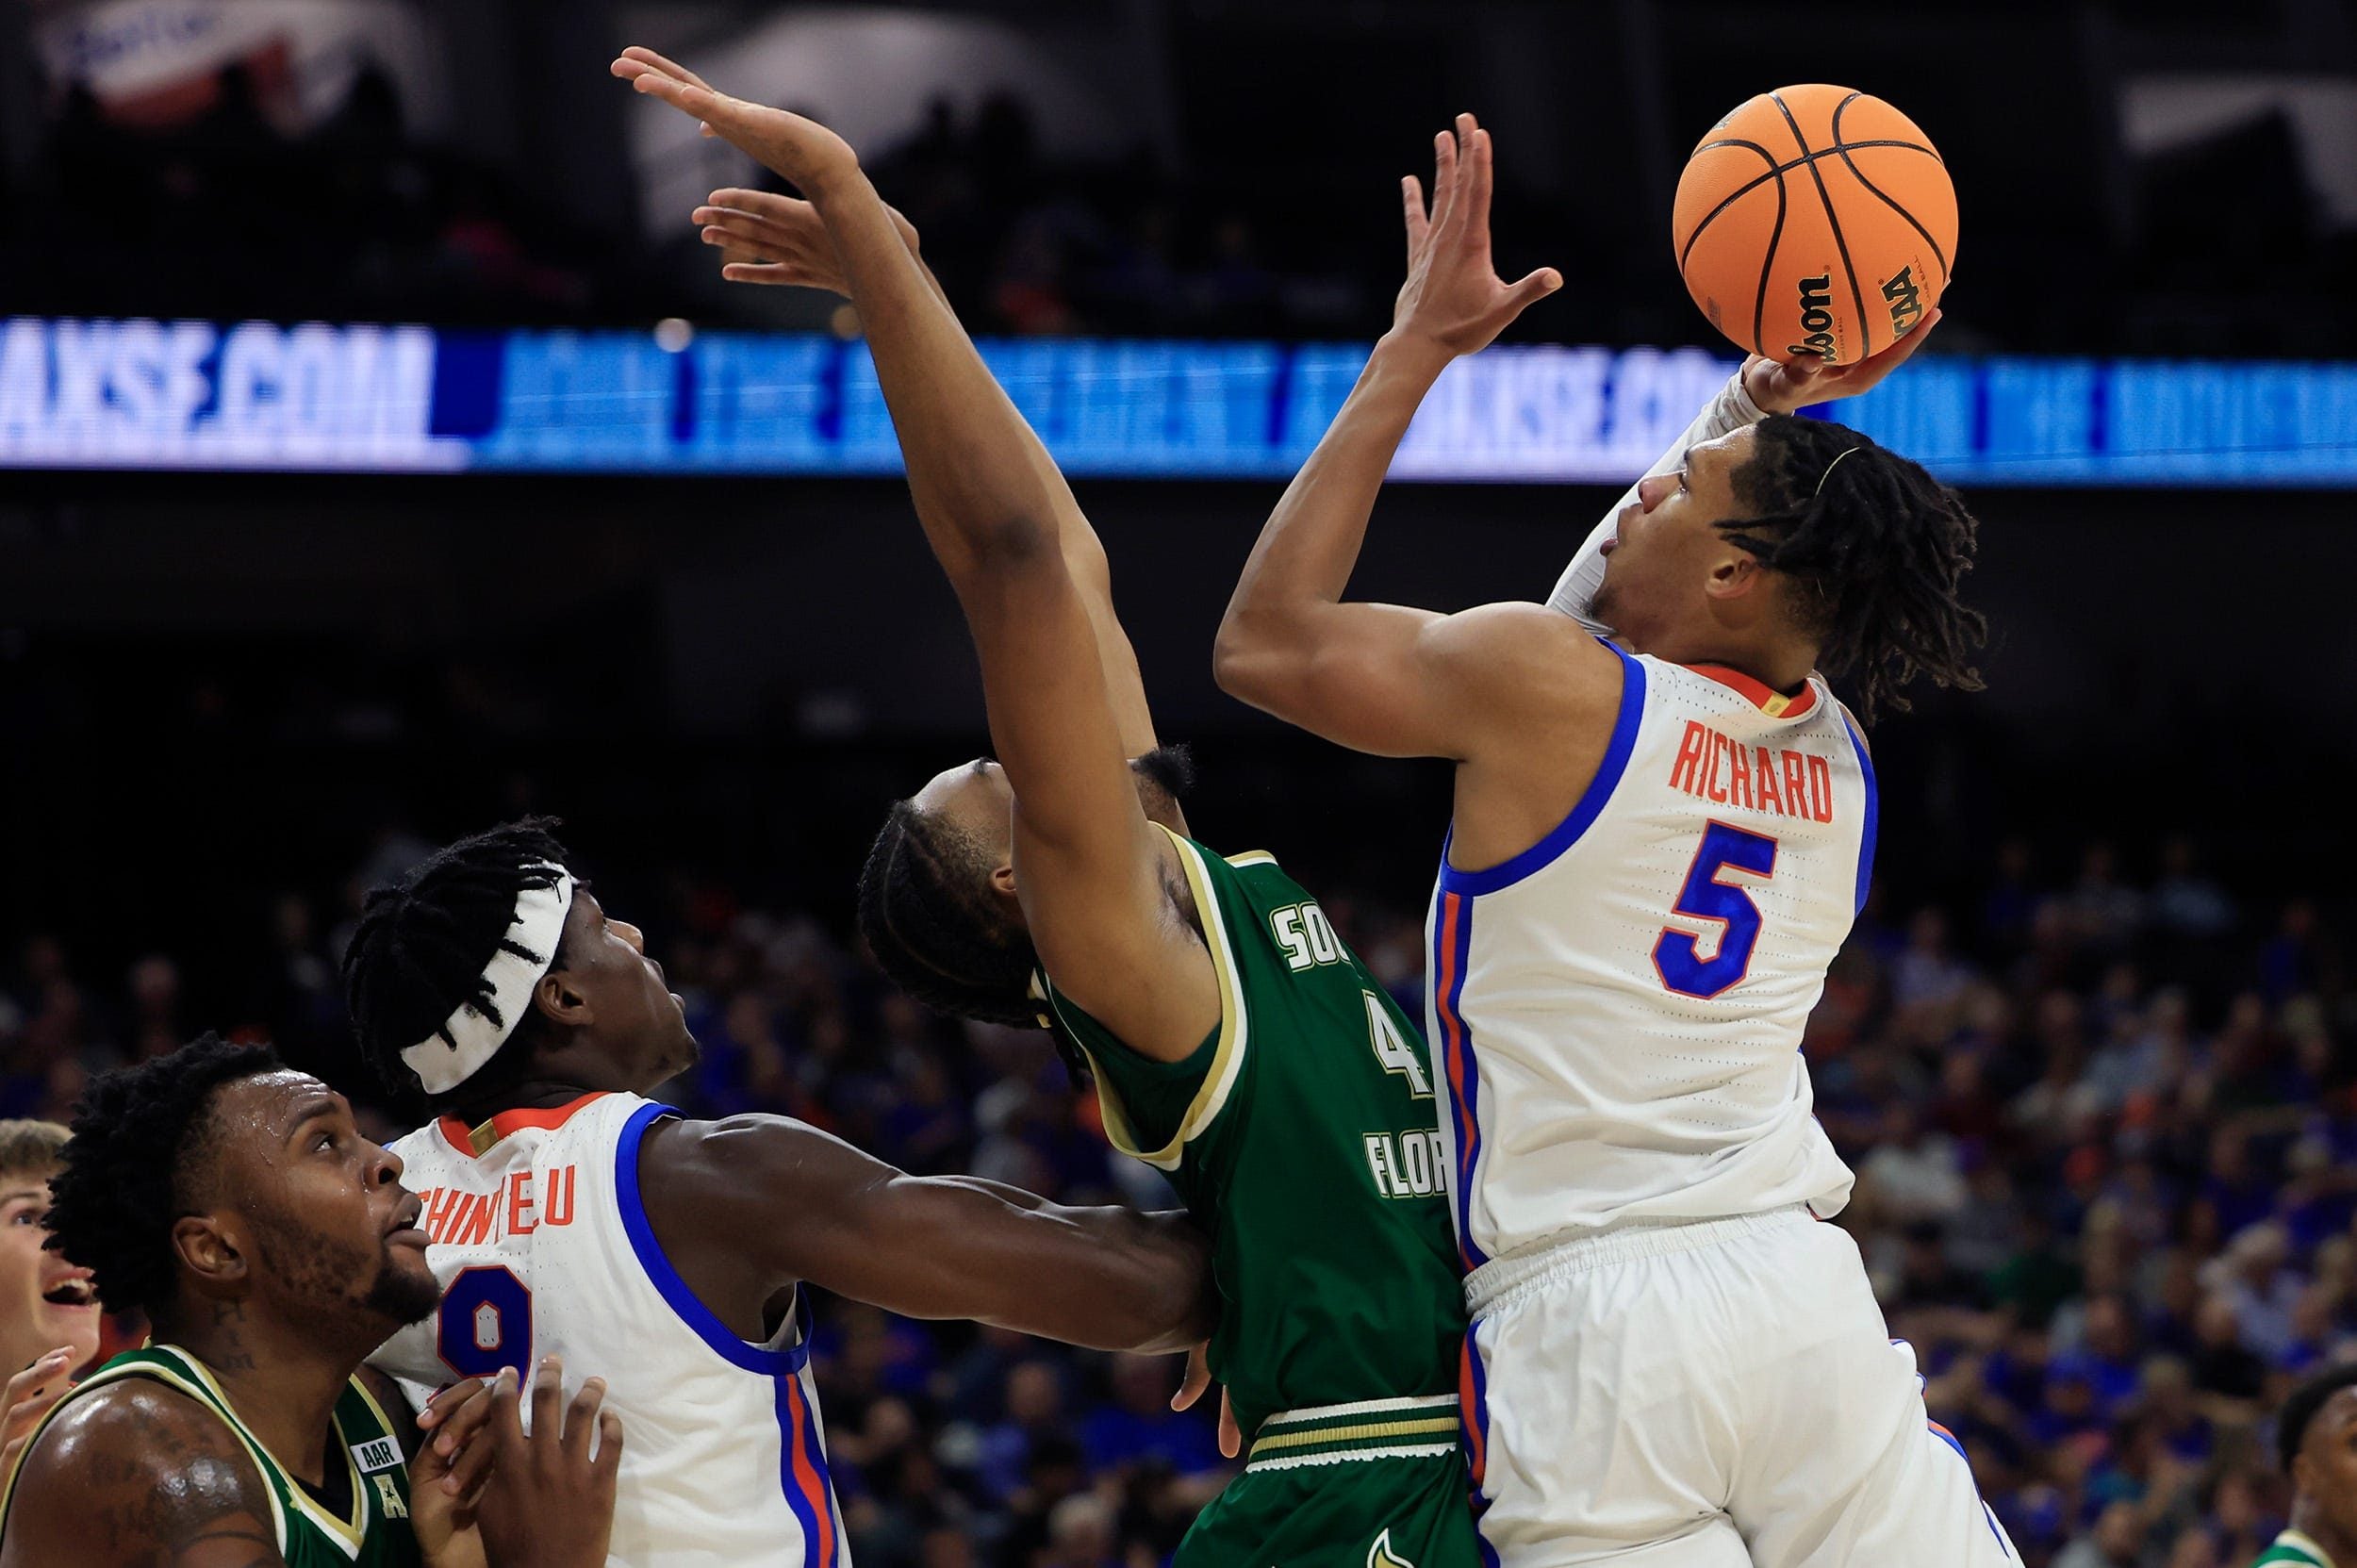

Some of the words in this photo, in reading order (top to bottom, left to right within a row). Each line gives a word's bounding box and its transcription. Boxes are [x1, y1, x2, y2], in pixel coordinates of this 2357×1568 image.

[1786, 273, 1838, 364] lson
[1880, 265, 1922, 340] CAA
[1668, 719, 1833, 824] RICHARD
[1651, 817, 1778, 1000] 5
[1361, 989, 1434, 1099] 4
[361, 1441, 395, 1468] AAR
